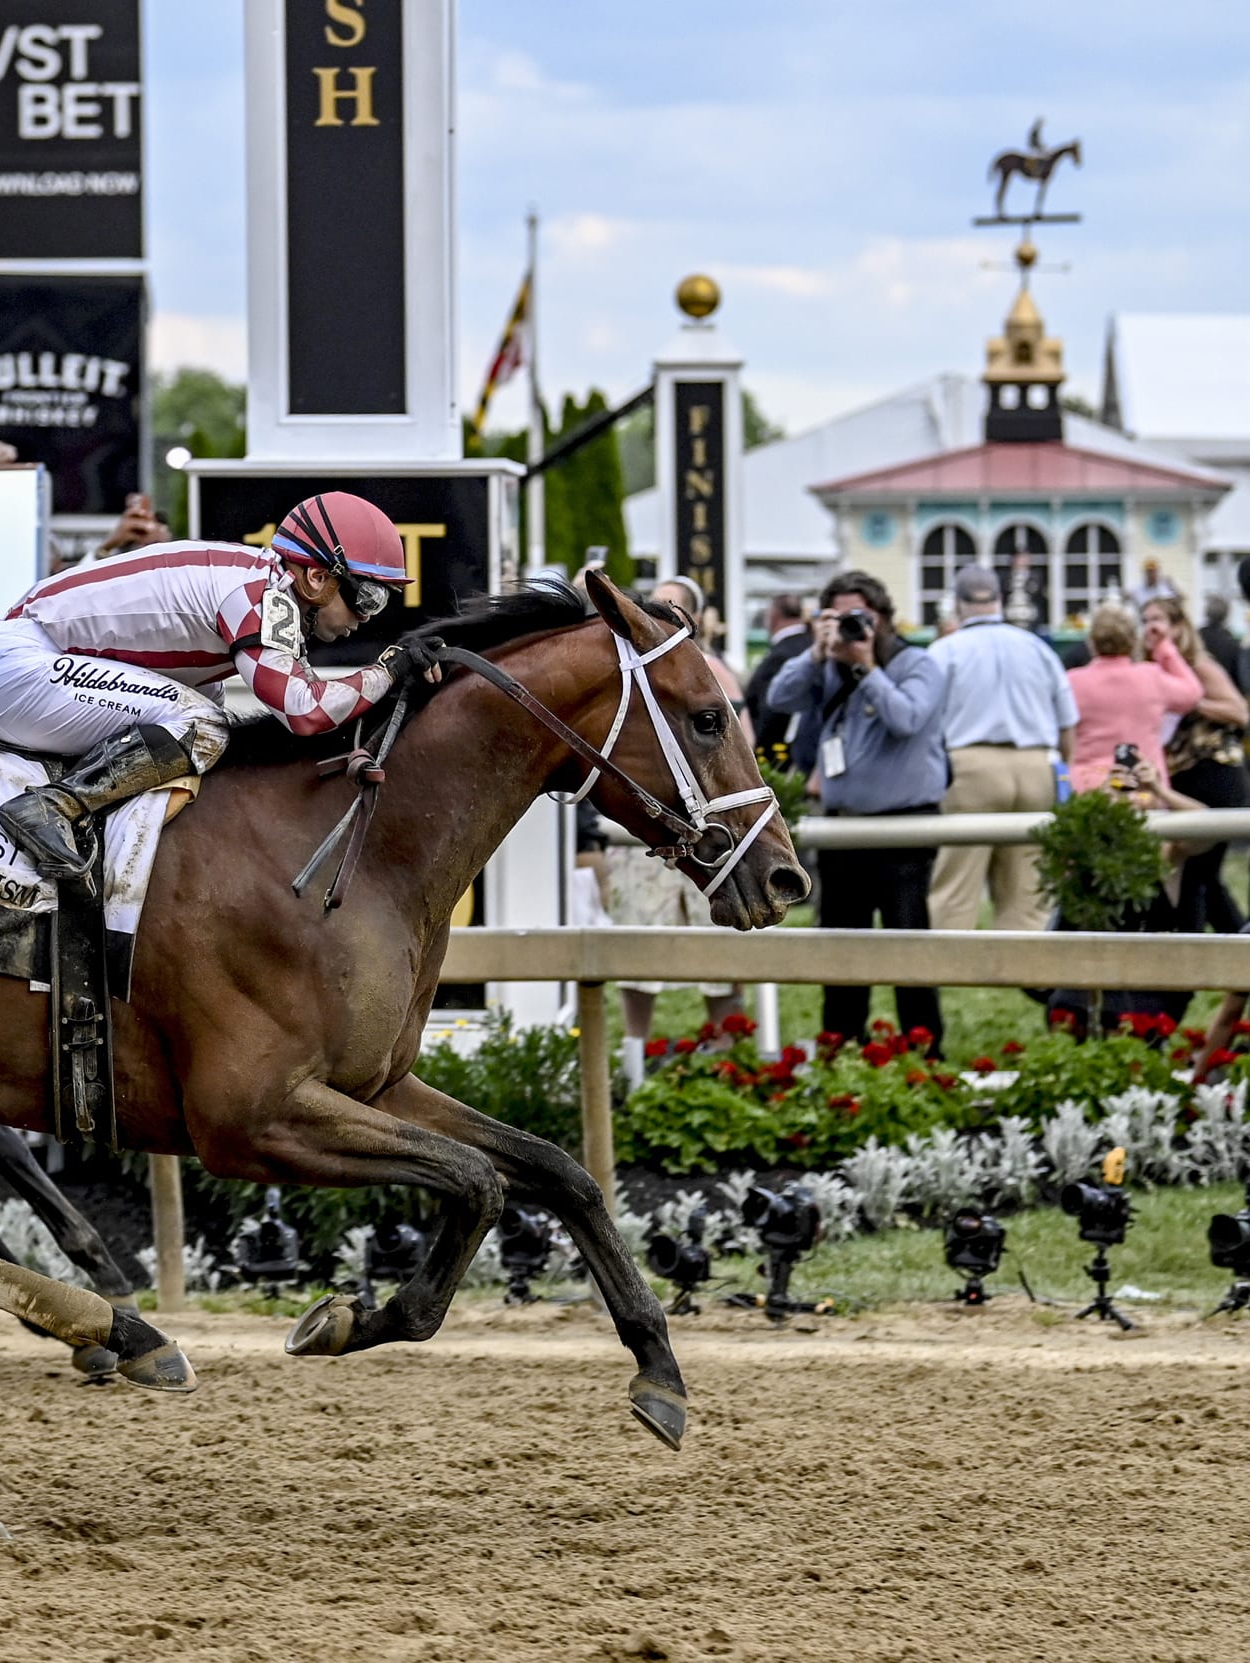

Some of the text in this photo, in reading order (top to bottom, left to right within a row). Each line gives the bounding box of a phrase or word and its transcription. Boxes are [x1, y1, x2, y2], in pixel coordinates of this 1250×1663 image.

[18, 82, 141, 139] BET
[85, 171, 138, 196] NOW
[685, 404, 716, 595] FINISH
[271, 595, 295, 650] 2
[49, 656, 180, 702] Hildebrandt's
[74, 693, 141, 717] ICE CREAM
